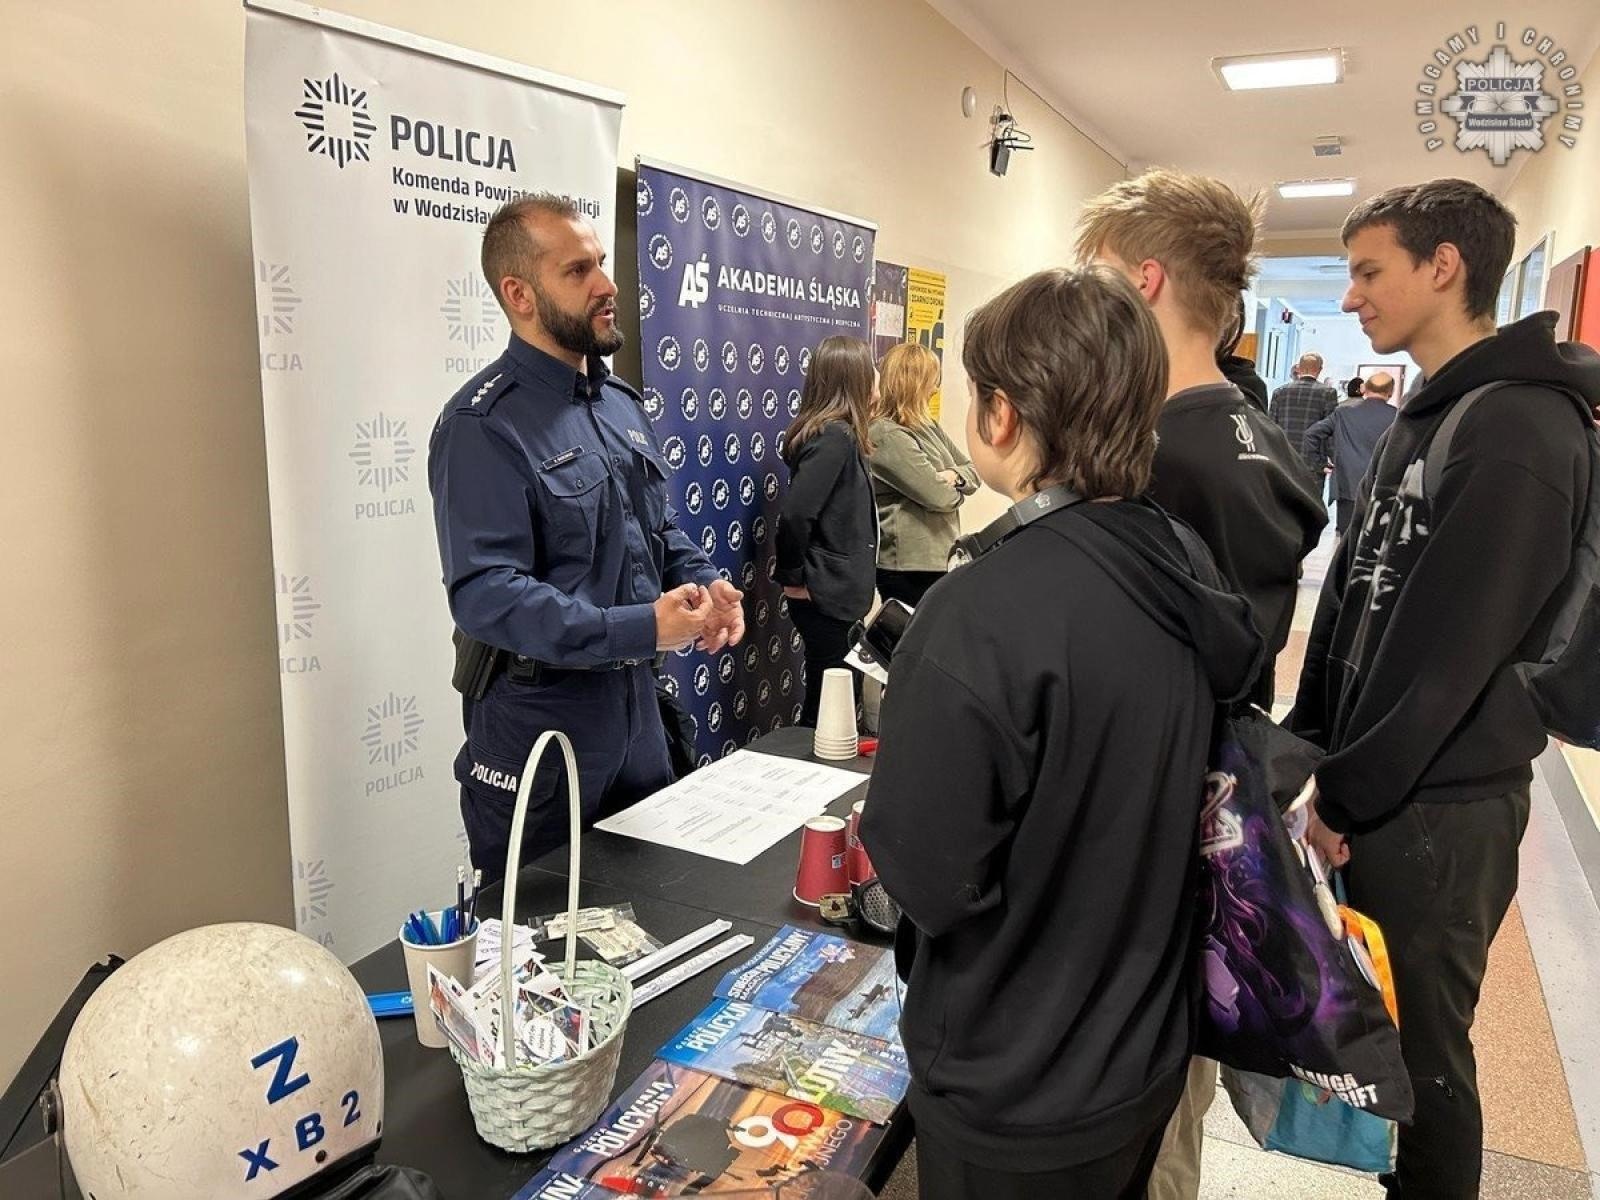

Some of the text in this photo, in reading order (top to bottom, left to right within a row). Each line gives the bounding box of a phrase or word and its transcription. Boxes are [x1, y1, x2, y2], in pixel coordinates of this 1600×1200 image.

[390, 115, 517, 172] POLICJA
[392, 167, 469, 196] Komenda
[475, 181, 559, 202] Powiat
[394, 199, 493, 225] w Wodzisła
[717, 265, 806, 301] AKADEMIA
[808, 277, 861, 311] ŚLĄSKA
[355, 498, 416, 520] POLICJA
[365, 766, 425, 797] POLICJA
[687, 1000, 750, 1052] POLICYJN
[251, 1036, 311, 1105] Z
